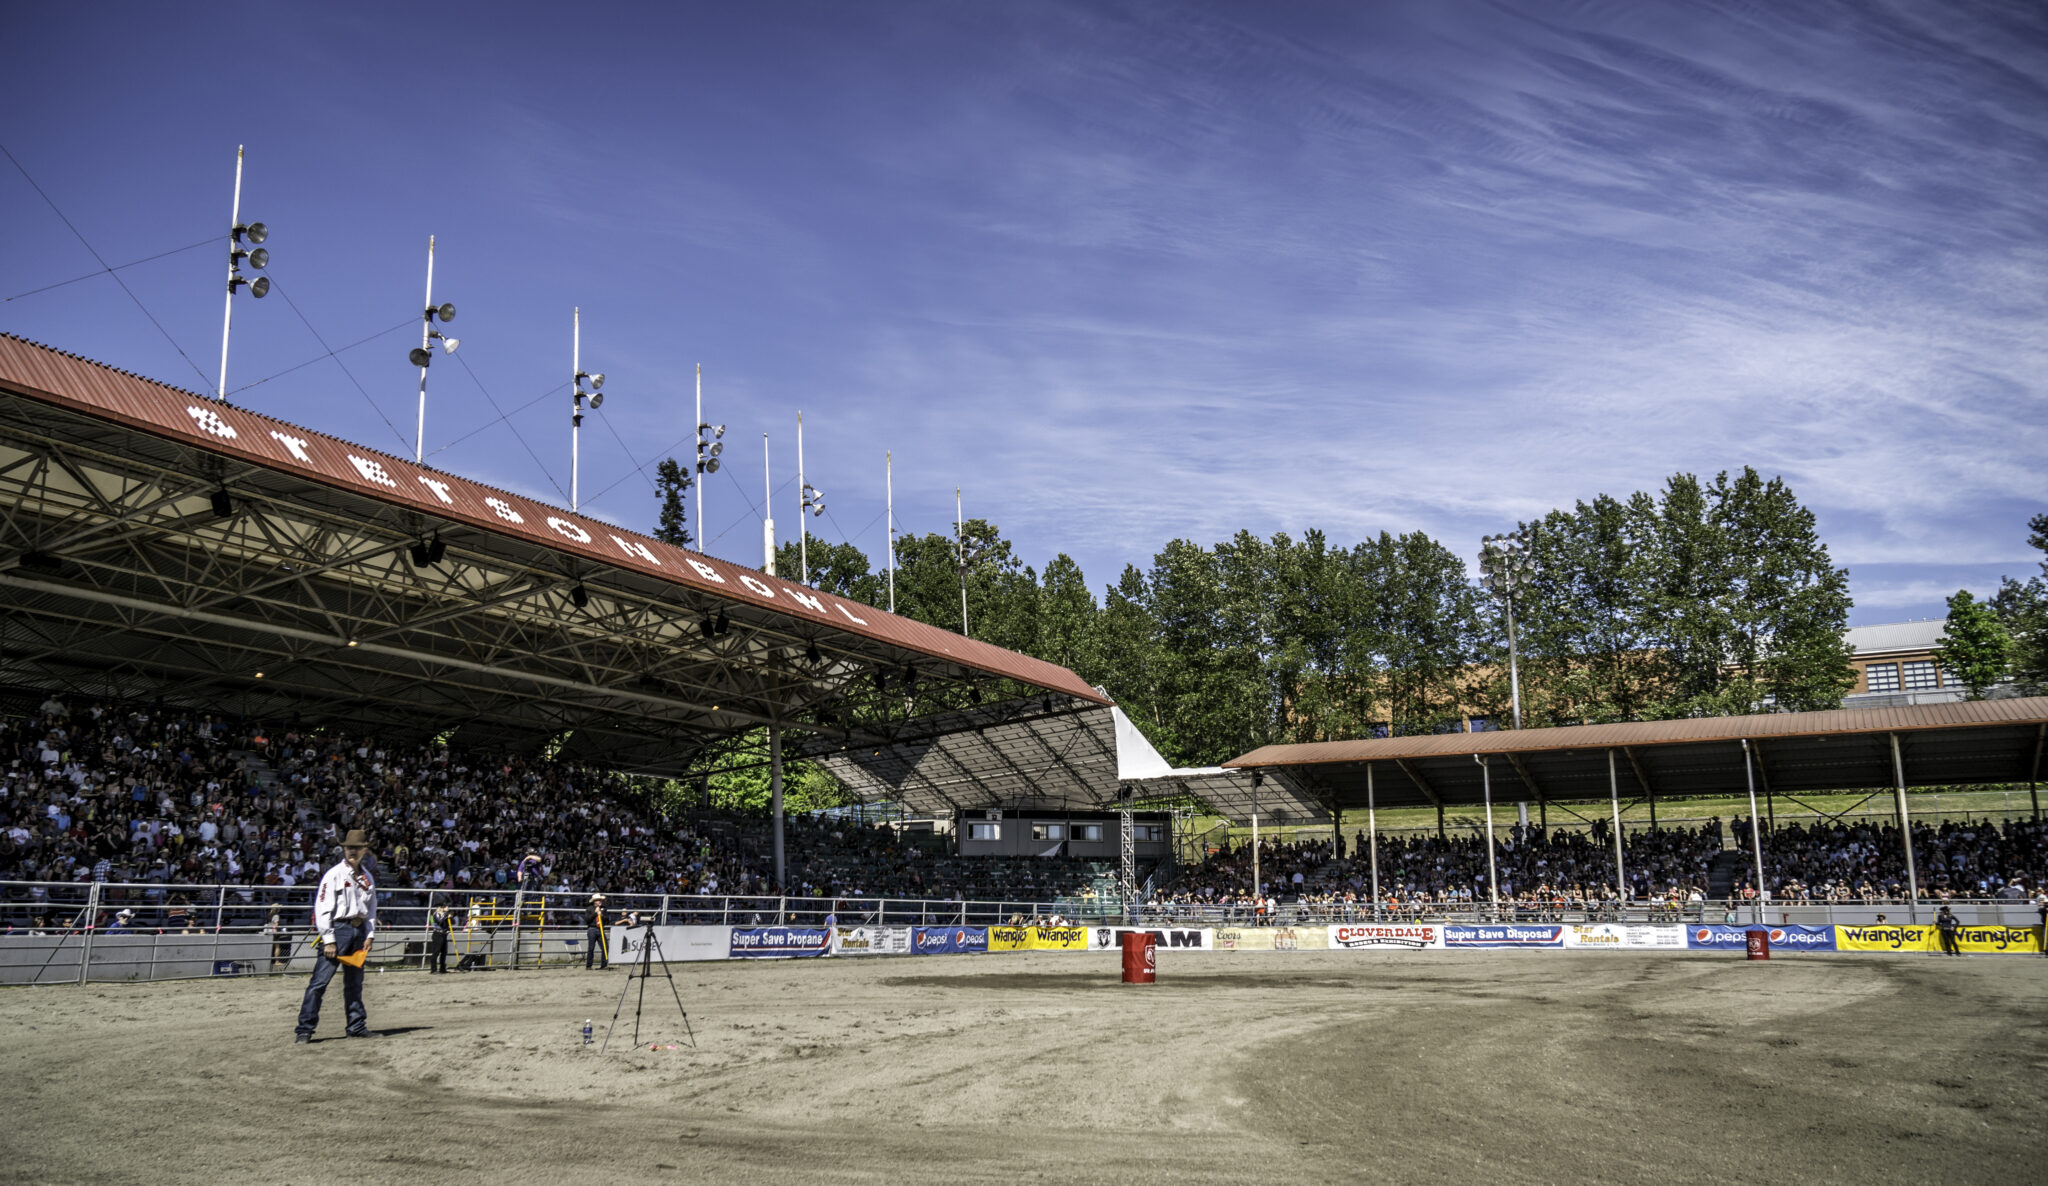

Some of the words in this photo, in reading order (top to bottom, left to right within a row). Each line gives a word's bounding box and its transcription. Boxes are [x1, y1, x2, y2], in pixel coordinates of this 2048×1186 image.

[187, 405, 661, 566] STETSON
[685, 558, 868, 626] BOWL
[1216, 929, 1241, 940] Coors
[1338, 928, 1434, 940] CLOVERDALE
[1446, 929, 1476, 942] Super
[1478, 929, 1505, 939] Save
[1507, 929, 1552, 942] Disposal
[1573, 925, 1594, 933] Star
[733, 932, 760, 949] Super
[763, 932, 784, 945] Save
[787, 932, 823, 949] Propane
[842, 938, 869, 948] Rentals
[927, 933, 948, 946] pepsi
[966, 933, 985, 946] pepsi
[992, 928, 1027, 948] Wrangler
[1037, 927, 1081, 947] Wrangler
[1580, 934, 1620, 943] Rentals
[1716, 932, 1747, 943] peps
[1789, 931, 1828, 943] pepsi
[1845, 927, 1924, 948] Wrangler
